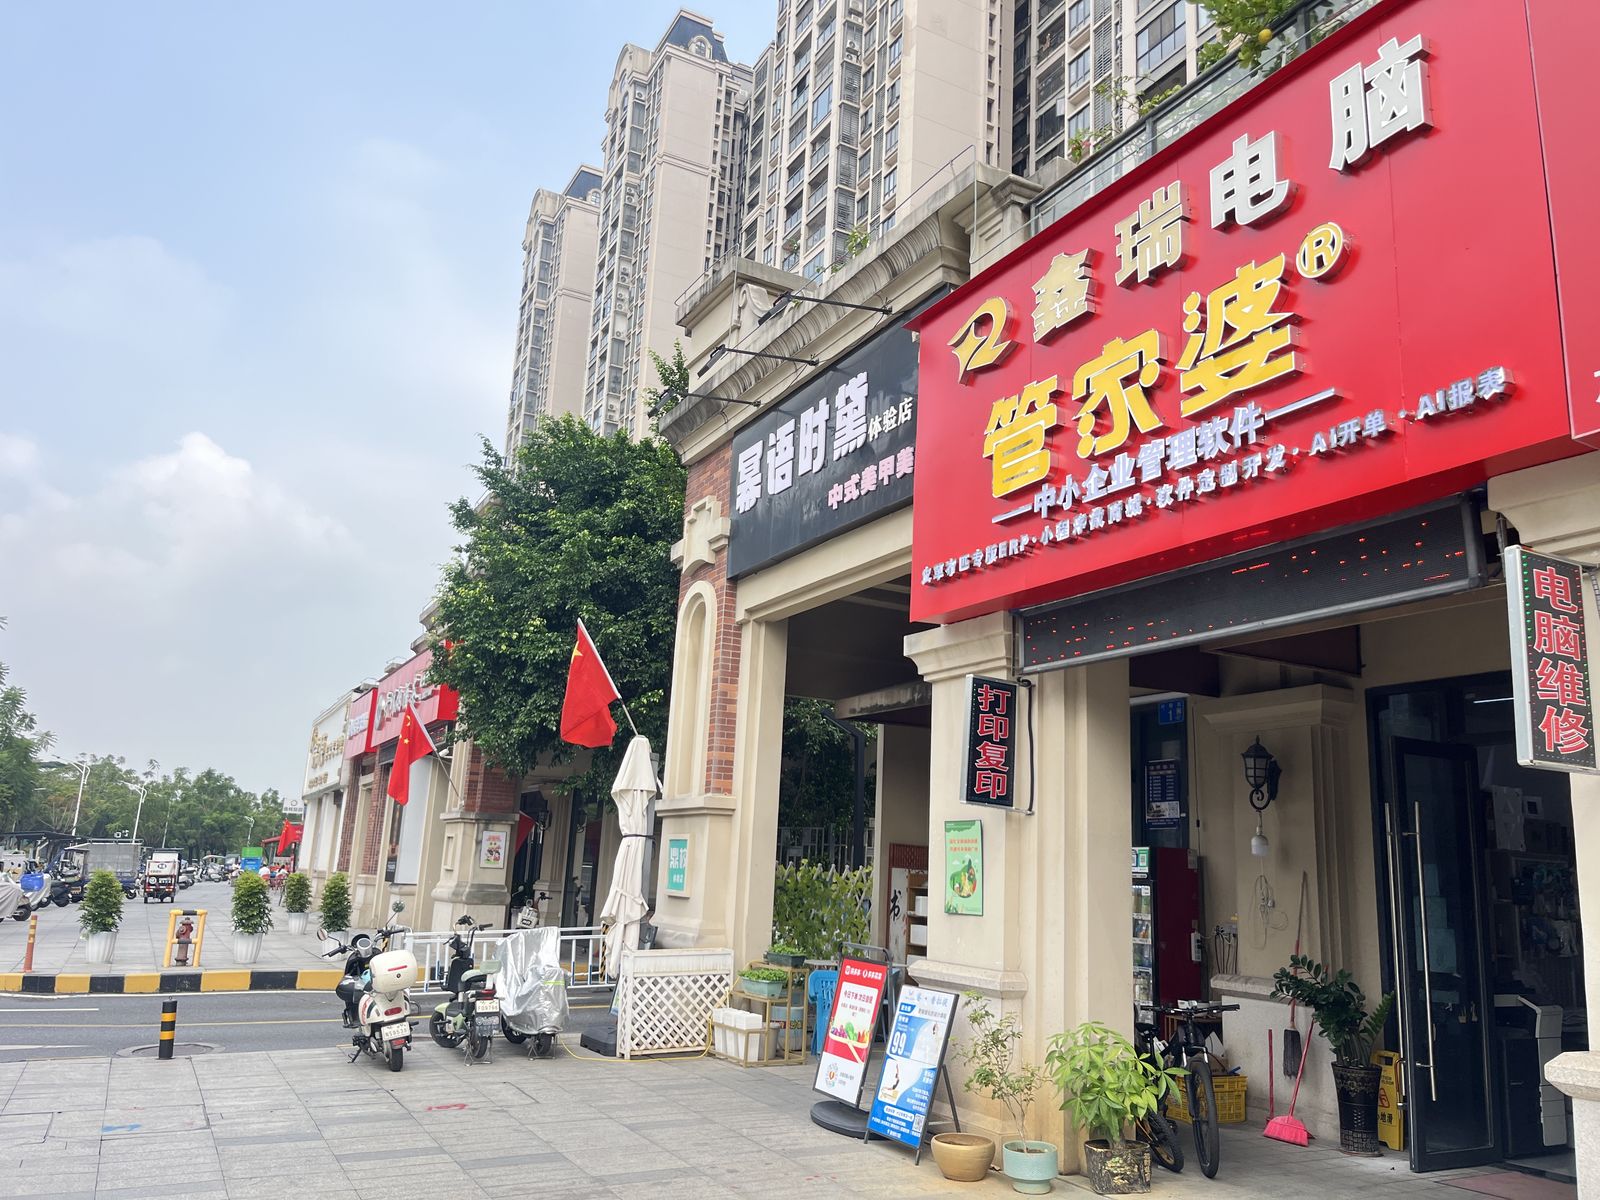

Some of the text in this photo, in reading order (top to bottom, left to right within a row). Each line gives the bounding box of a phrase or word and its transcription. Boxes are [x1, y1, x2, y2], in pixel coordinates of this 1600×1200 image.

[1032, 34, 1433, 344] 鑫瑞电脑
[868, 397, 913, 442] 体验店
[1532, 566, 1589, 755] 电脑维修
[973, 683, 1011, 799] 打印复印
[891, 1031, 907, 1056] 99
